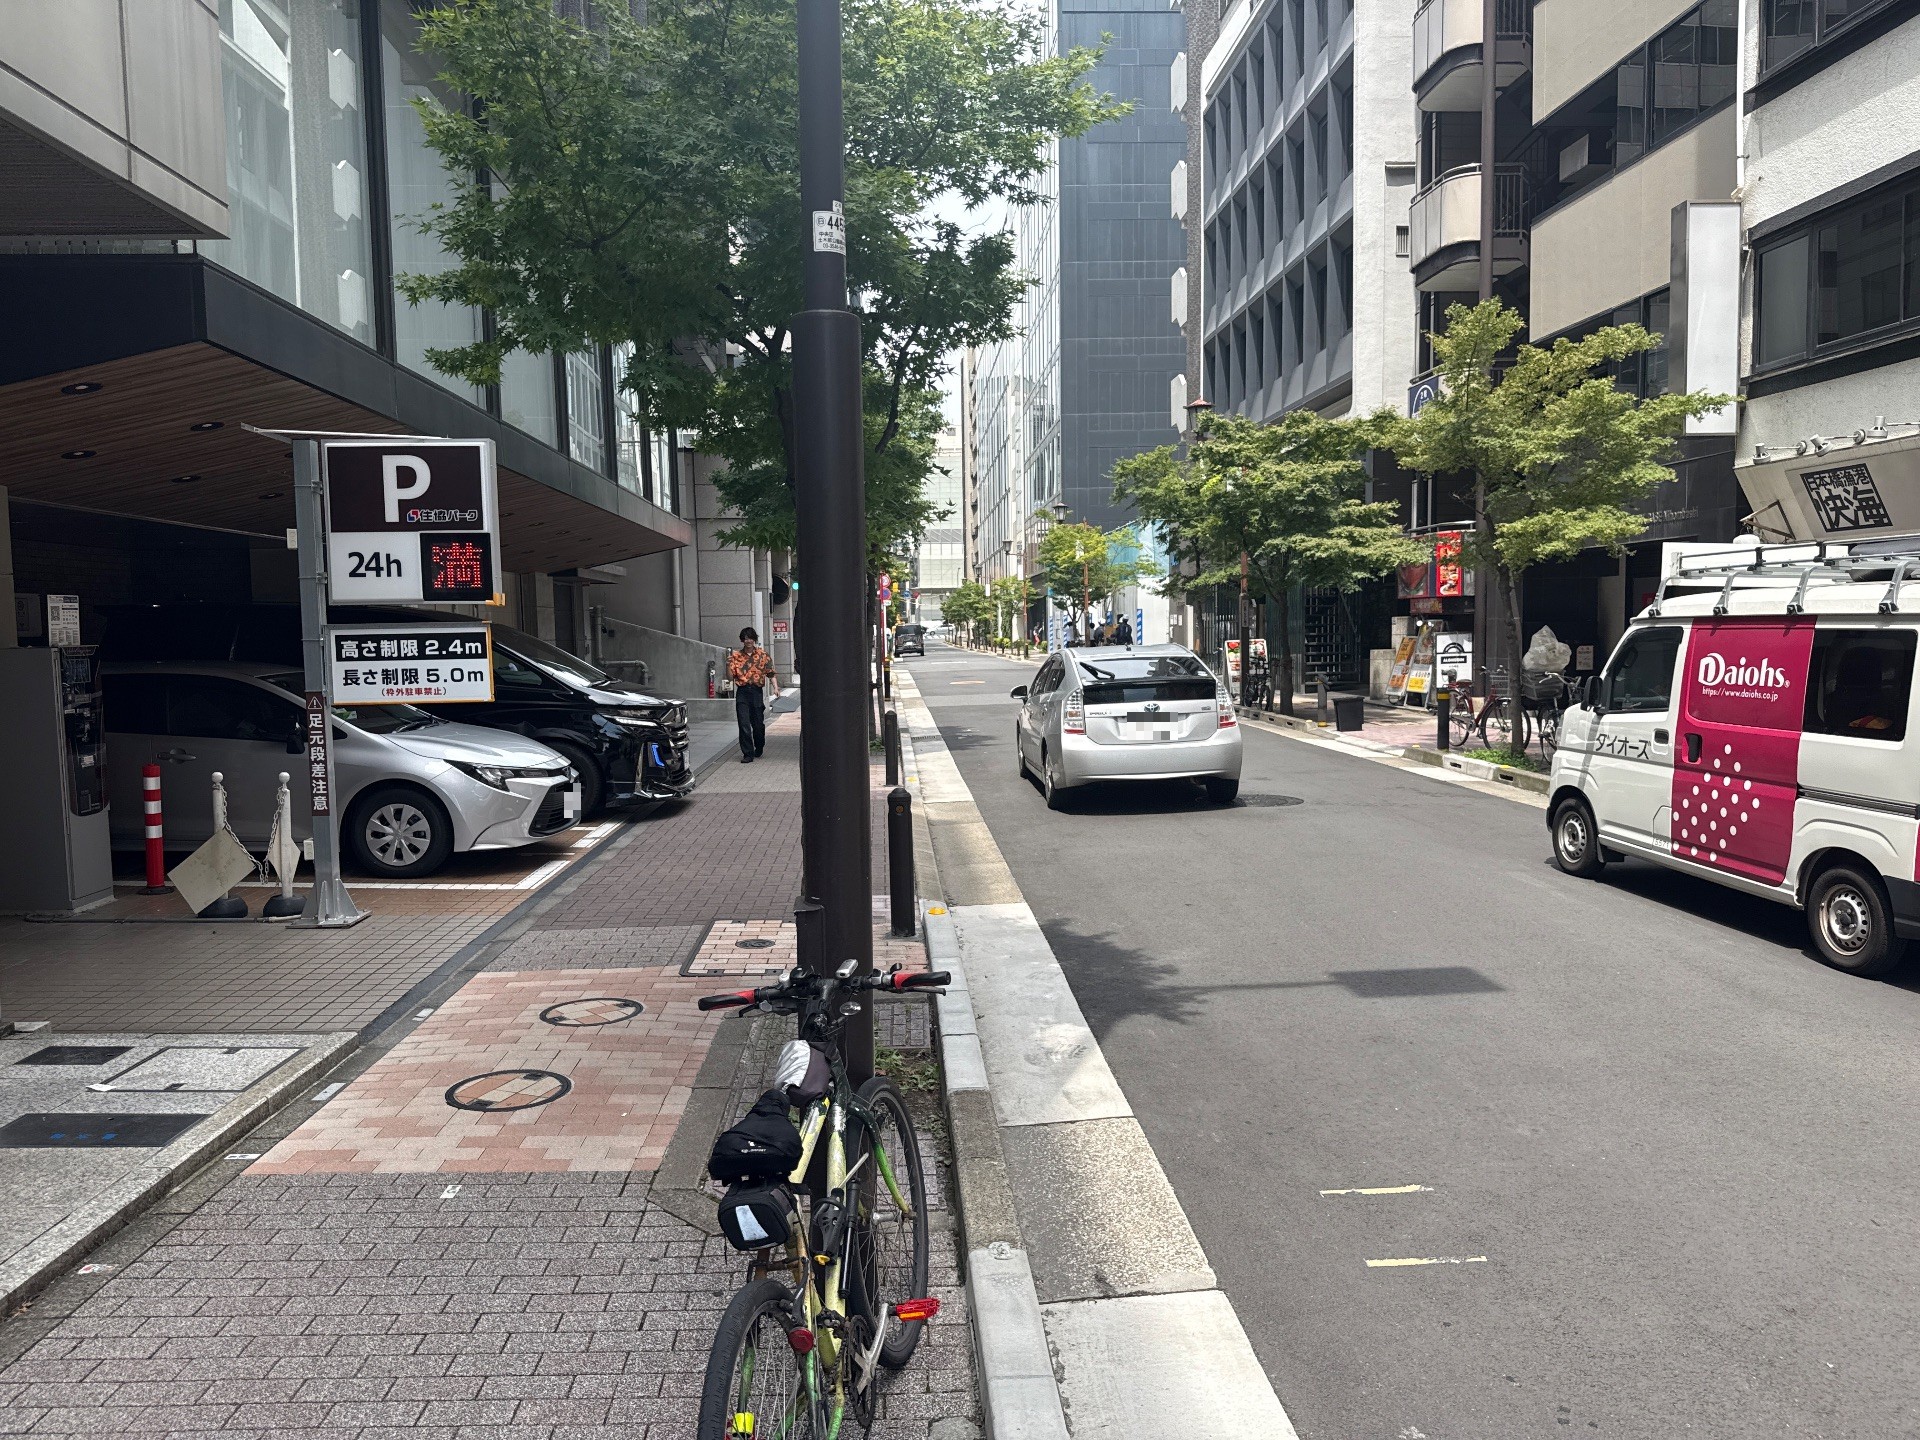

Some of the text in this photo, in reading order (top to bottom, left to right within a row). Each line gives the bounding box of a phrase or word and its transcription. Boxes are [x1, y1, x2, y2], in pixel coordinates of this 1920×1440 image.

[382, 454, 431, 523] P
[1806, 466, 1871, 491] 日本橋漁港
[419, 509, 478, 522] 住協パーク
[1814, 486, 1890, 530] 快海
[348, 551, 402, 578] 24h
[431, 542, 483, 588] 満
[340, 639, 482, 659] 高さ制限 2.4m
[342, 667, 484, 686] 長さ制限 5.0m
[1698, 652, 1786, 688] Daiohs
[1595, 733, 1651, 760] ダイオーズ
[308, 713, 328, 811] 足元段差注意
